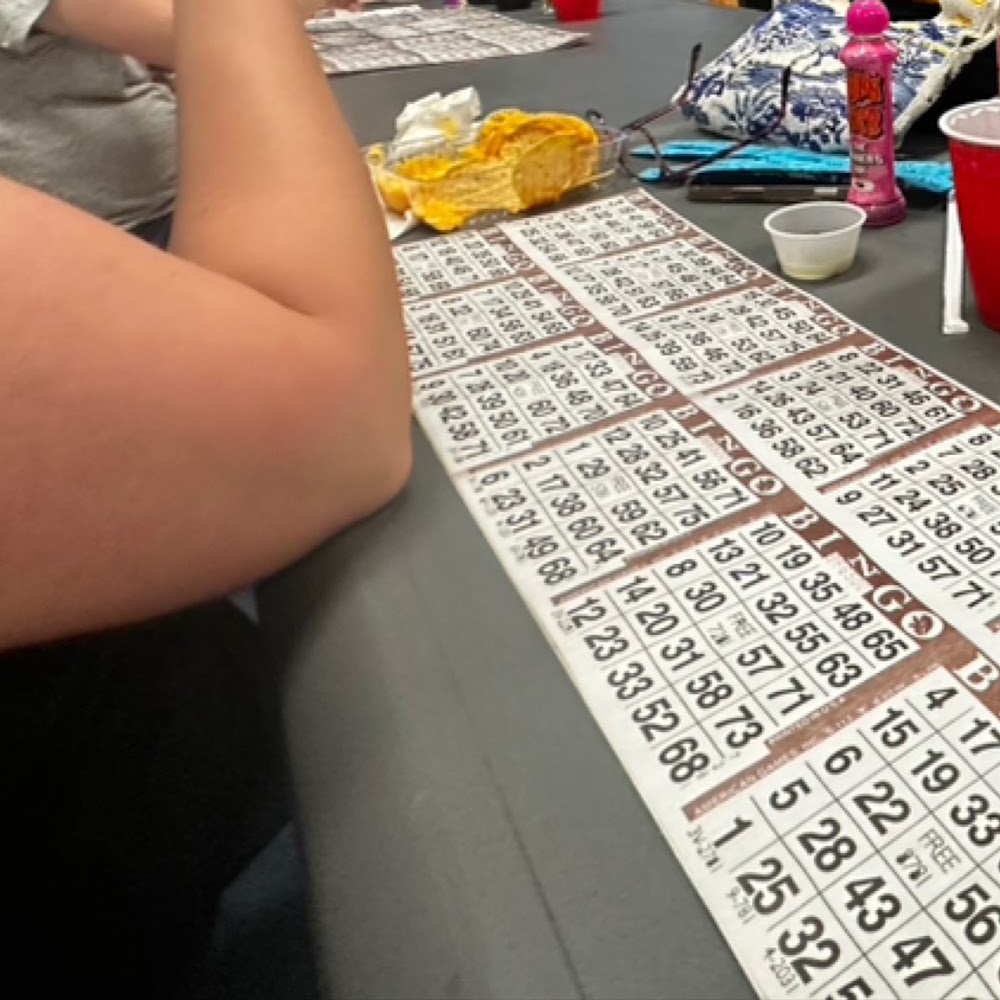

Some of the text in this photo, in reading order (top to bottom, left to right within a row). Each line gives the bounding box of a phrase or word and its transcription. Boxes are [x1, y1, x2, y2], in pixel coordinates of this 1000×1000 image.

[480, 470, 510, 486] 6
[565, 442, 668, 546] 1 29 59 62
[634, 462, 668, 486] 32
[652, 483, 690, 504] 57
[674, 502, 710, 527] 75
[654, 430, 688, 450] 25
[676, 448, 706, 468] 41
[714, 486, 749, 510] 71
[904, 460, 931, 475] 2
[927, 474, 966, 496] 25
[938, 445, 964, 458] 7
[960, 459, 997, 481] 28
[491, 488, 527, 512] 23
[505, 509, 542, 534] 31
[522, 455, 625, 564] 2 17 38 60 64
[870, 473, 901, 491] 11
[893, 490, 932, 512] 24
[923, 512, 963, 539] 38
[955, 537, 996, 564] 50
[537, 556, 578, 586] 68
[836, 490, 994, 608] 9 27 31 57 71
[567, 597, 607, 628] 12
[708, 538, 862, 688] 13 21 32 55 63
[750, 521, 909, 662] 10 19 35 48 65
[583, 625, 630, 662] 23
[616, 576, 764, 749] 14 20 31 58 73
[665, 559, 698, 578] 8
[684, 581, 727, 613] 30
[737, 644, 785, 676] 57
[767, 676, 814, 716] 71
[607, 662, 654, 700] 33
[925, 687, 959, 711] 4
[631, 697, 680, 742] 52
[871, 708, 920, 748] 15
[911, 749, 960, 794] 19
[659, 737, 710, 783] 68
[824, 746, 862, 775] 6
[852, 781, 911, 836] 22
[917, 828, 962, 874] FREE
[713, 817, 841, 985] 1 25 32
[769, 778, 812, 811] 5
[797, 817, 857, 873] 28
[844, 876, 902, 933] 43
[891, 936, 956, 988] 47
